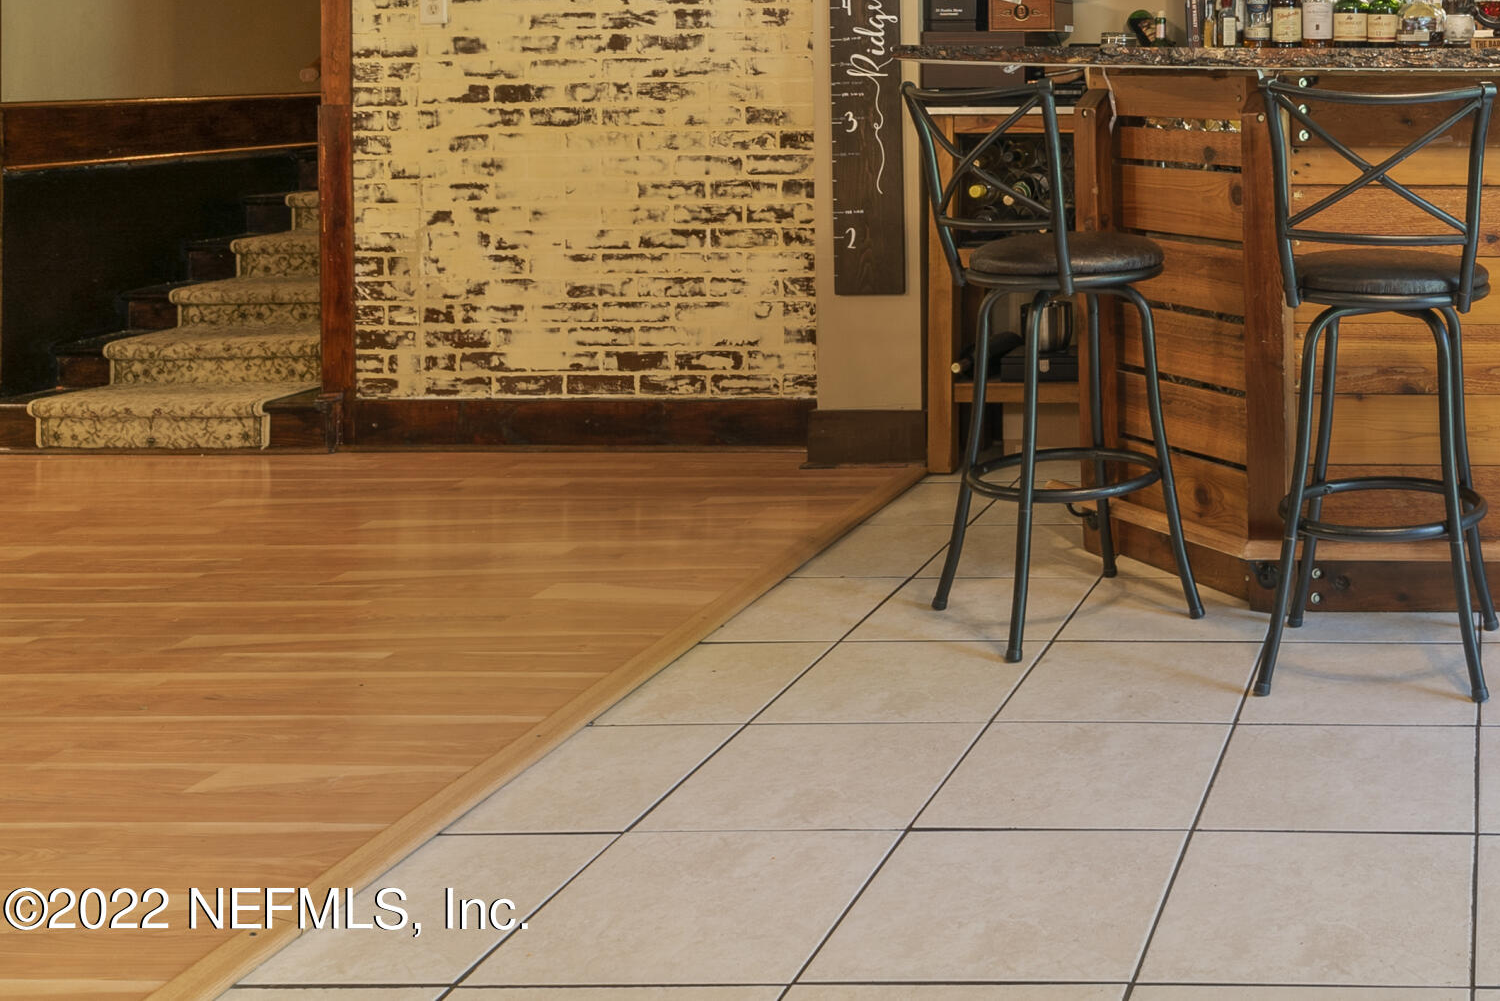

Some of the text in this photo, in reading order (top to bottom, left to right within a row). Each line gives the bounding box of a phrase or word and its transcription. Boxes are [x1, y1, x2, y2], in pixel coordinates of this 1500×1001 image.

[1475, 40, 1487, 48] THE
[844, 111, 858, 132] 3
[845, 227, 857, 249] 2
